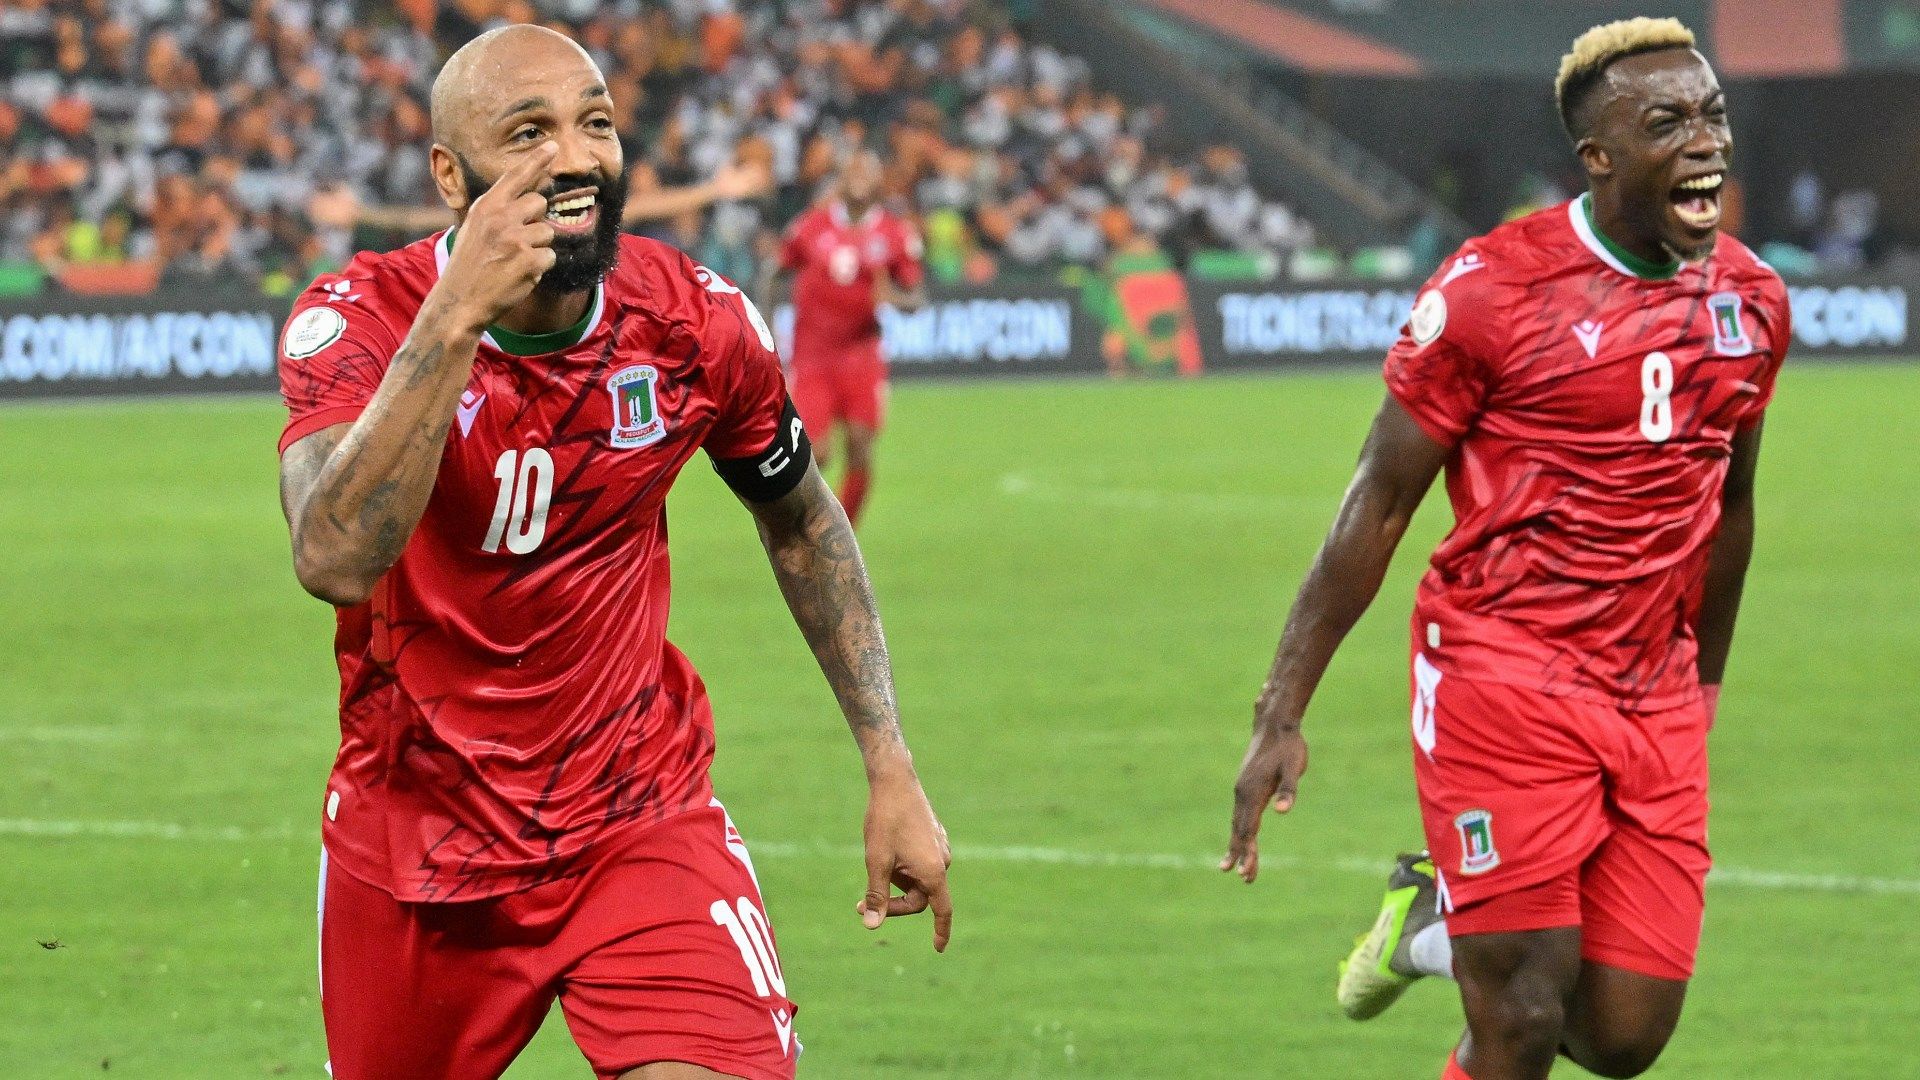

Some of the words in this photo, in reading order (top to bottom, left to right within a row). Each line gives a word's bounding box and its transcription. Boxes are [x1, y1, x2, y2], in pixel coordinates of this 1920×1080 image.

[1639, 351, 1674, 443] 8
[481, 447, 555, 555] 10
[709, 895, 787, 998] 10
